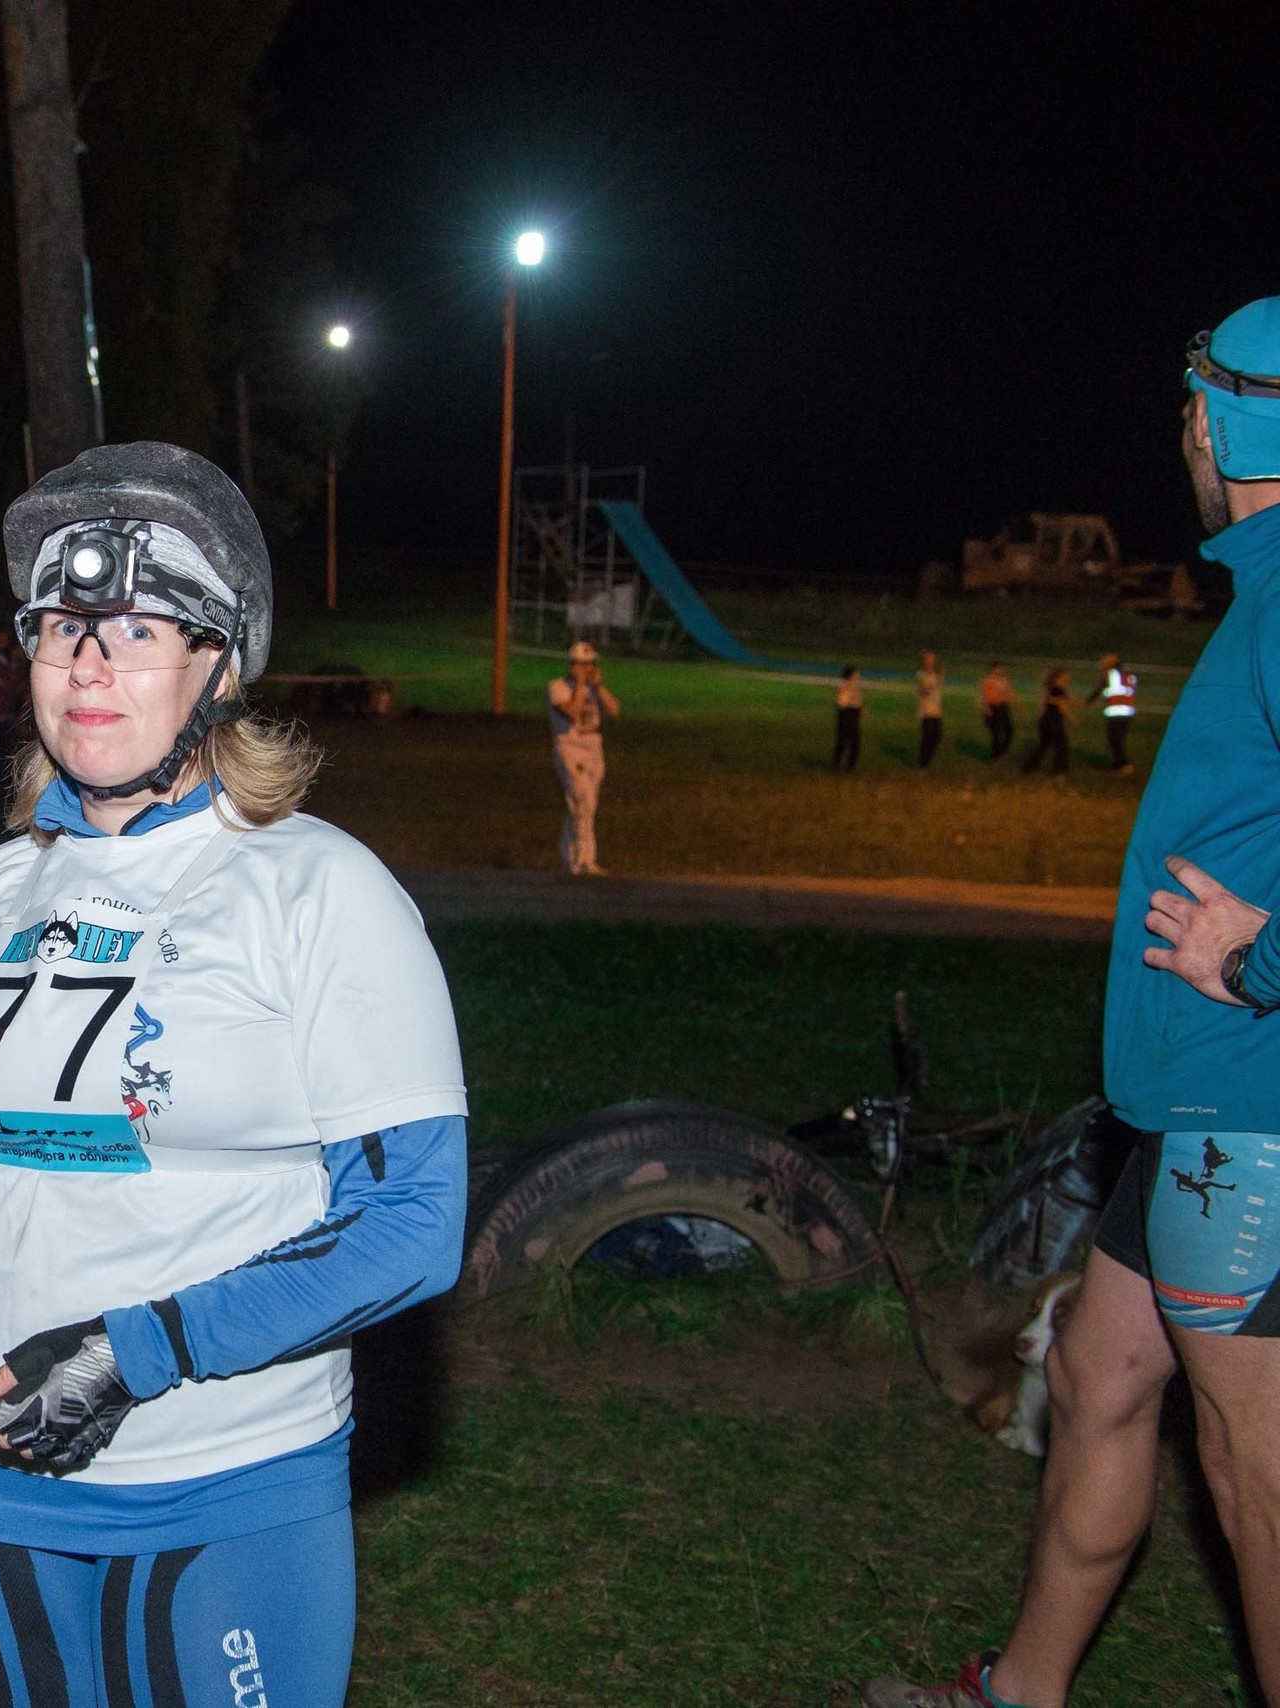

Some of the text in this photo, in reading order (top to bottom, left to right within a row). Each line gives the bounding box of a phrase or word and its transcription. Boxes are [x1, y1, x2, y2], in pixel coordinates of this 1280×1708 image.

[67, 920, 144, 963] HEY
[157, 928, 180, 964] СОВ
[79, 1150, 130, 1163] области
[1228, 1194, 1266, 1276] CZECH
